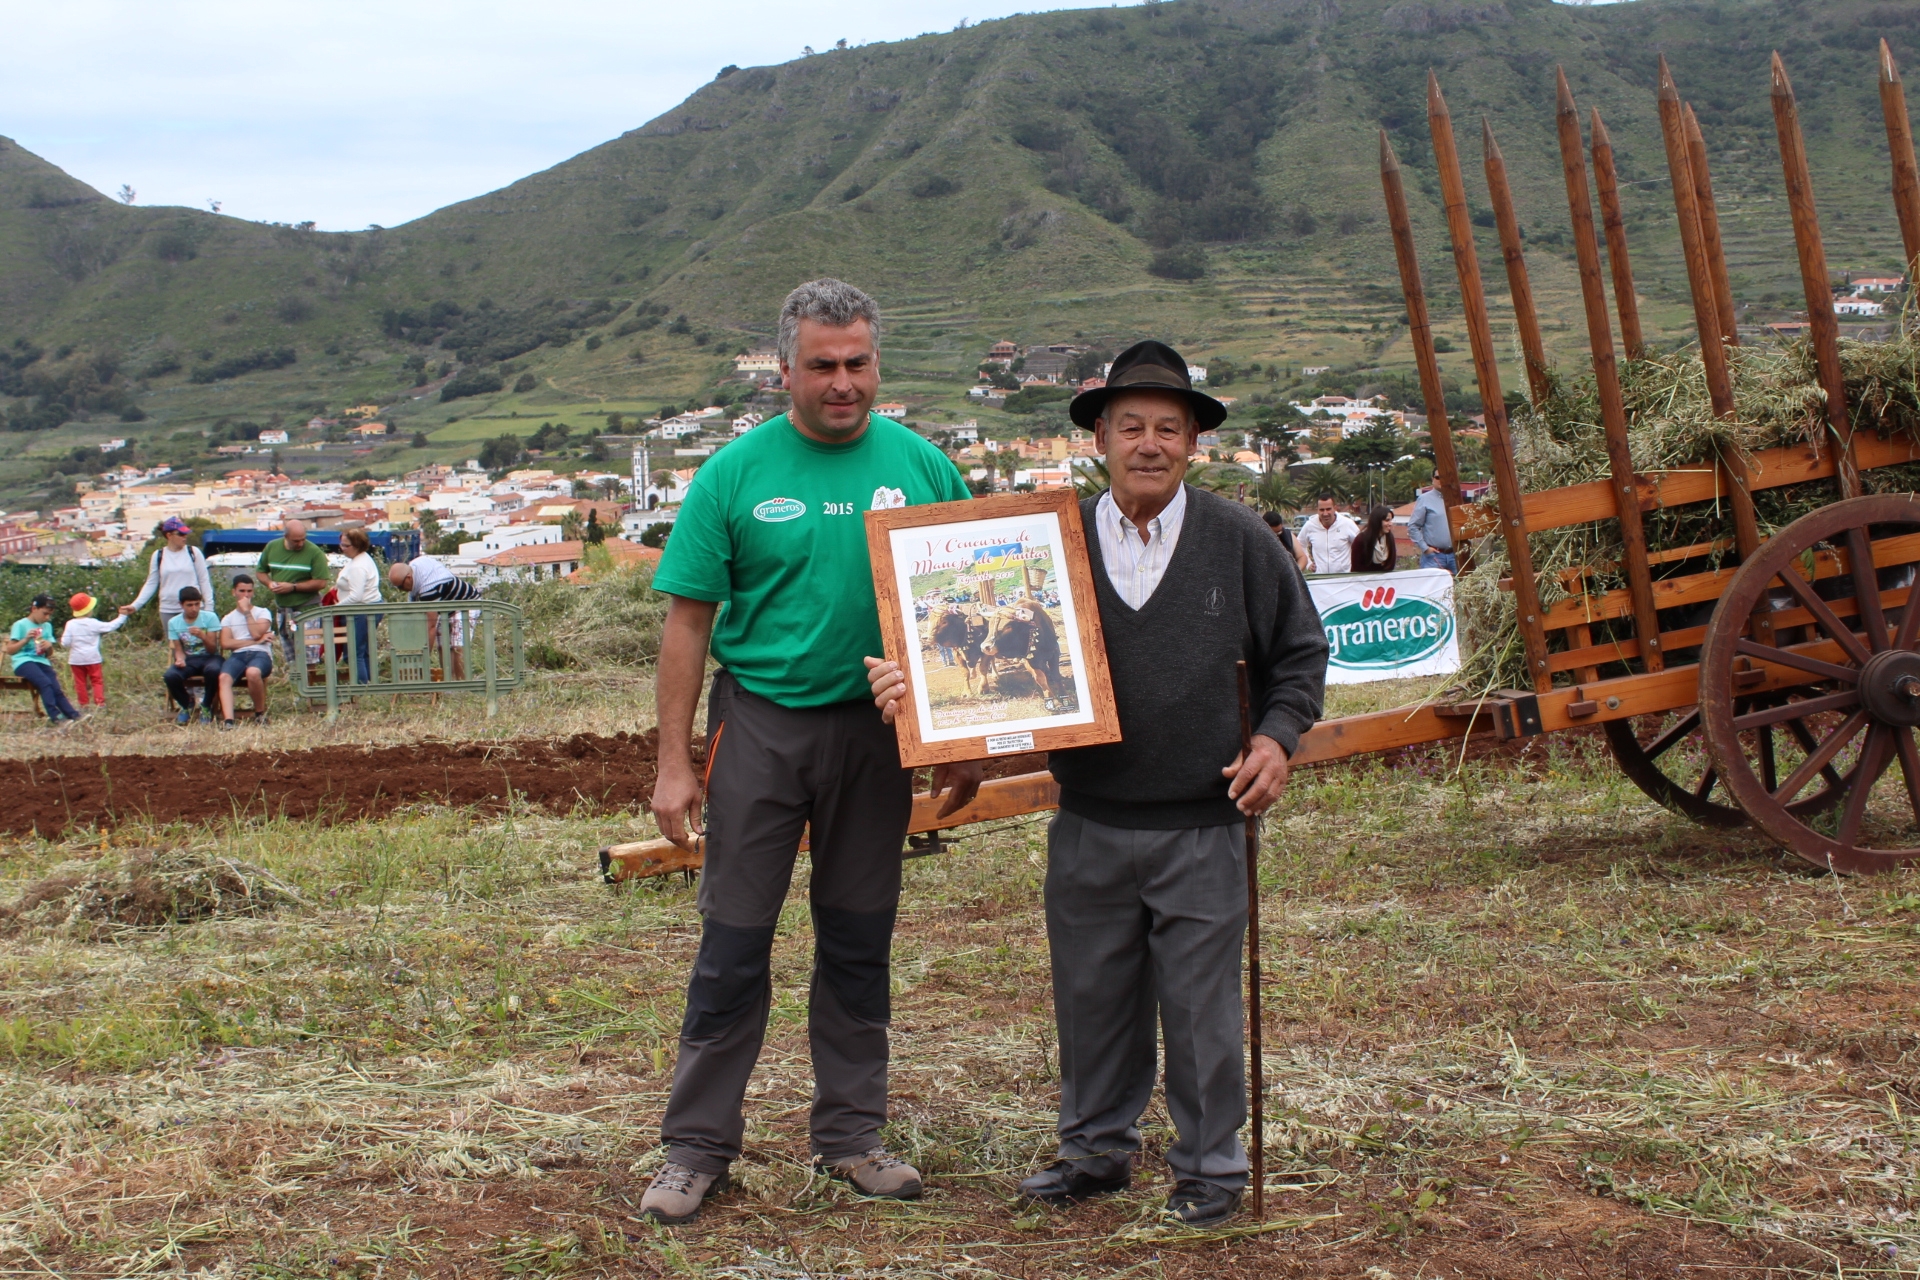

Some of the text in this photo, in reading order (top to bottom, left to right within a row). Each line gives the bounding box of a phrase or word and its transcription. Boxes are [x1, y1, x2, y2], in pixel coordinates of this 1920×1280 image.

[759, 502, 854, 518] graneros 2015
[926, 529, 1031, 557] V Concurso de
[912, 546, 1049, 575] Manejo de Yuntas
[1325, 614, 1438, 656] graneros
